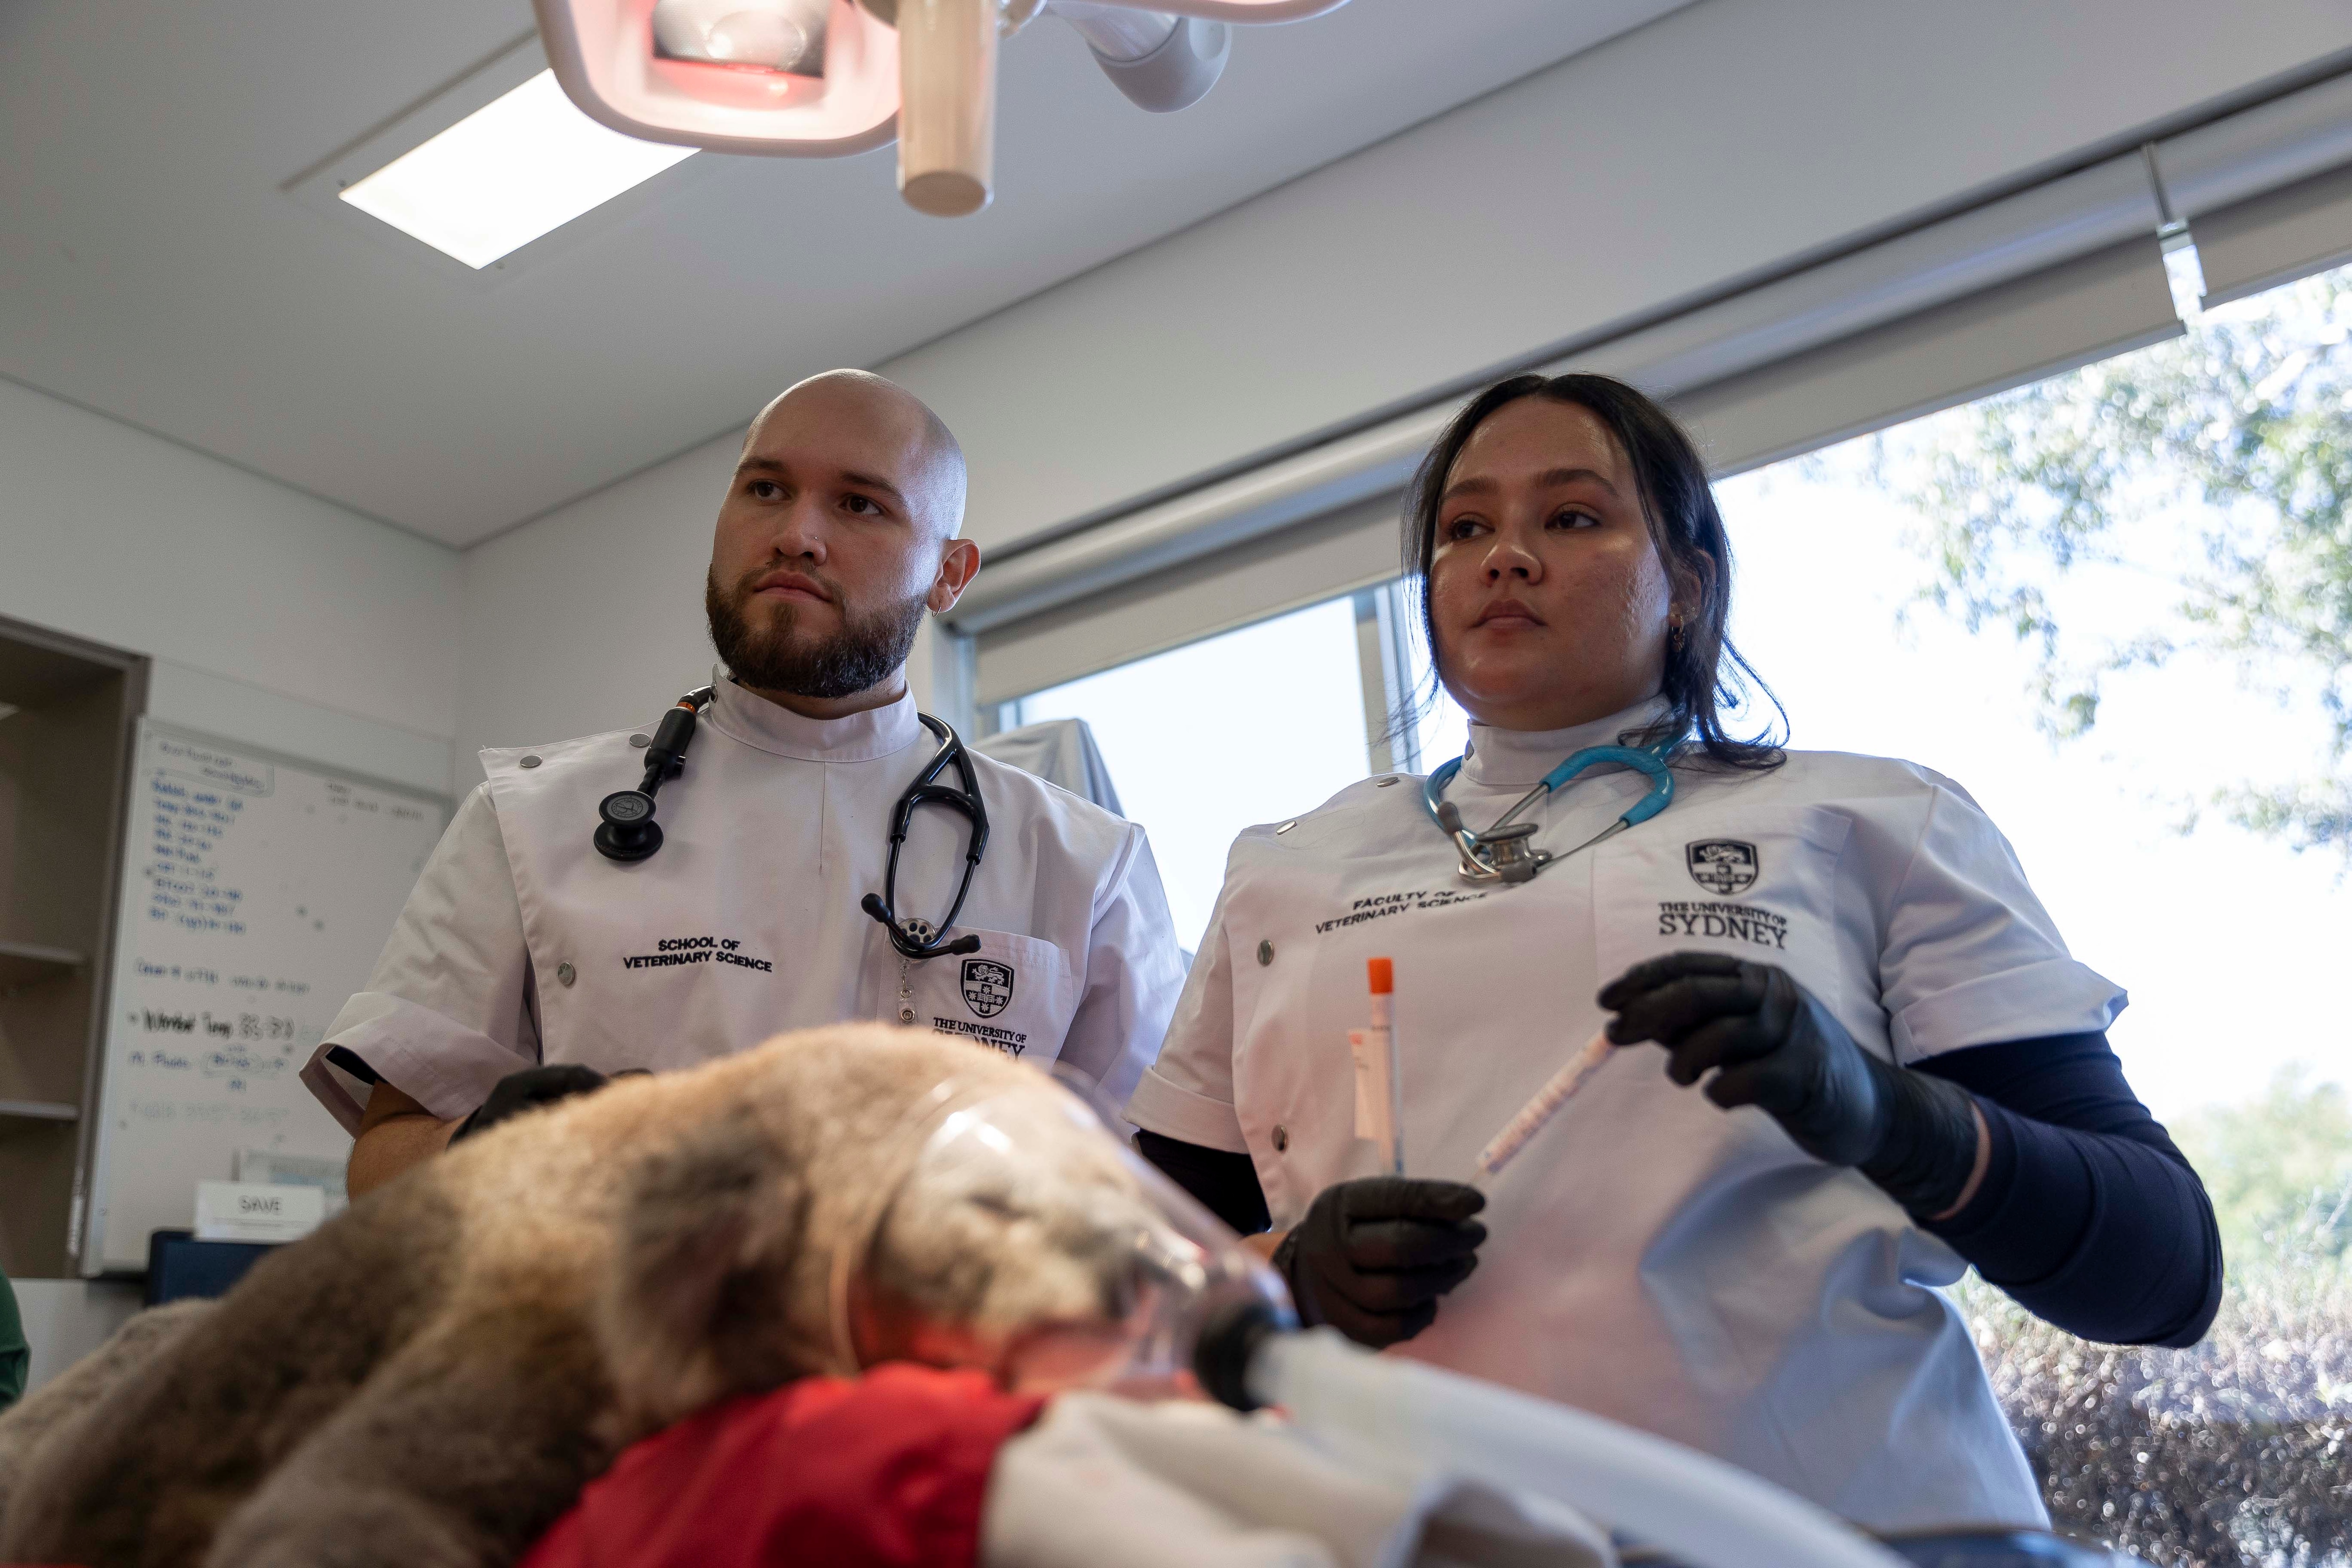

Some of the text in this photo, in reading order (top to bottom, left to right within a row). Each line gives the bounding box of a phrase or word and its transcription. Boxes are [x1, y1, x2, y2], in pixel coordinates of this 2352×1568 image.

[1352, 891, 1428, 910] FACULTY
[1315, 903, 1410, 934] VETERINARY
[1659, 901, 1787, 925] THE UNIVERSITY OF
[1659, 913, 1787, 949] SYDNEY
[659, 937, 740, 951] SCHOOL OF
[623, 951, 772, 972] VETERINARY SCIENCE
[933, 1017, 1027, 1043] THE UNIVERSITY OF
[932, 1028, 1025, 1061] NEY
[239, 1195, 280, 1214] SAVE
